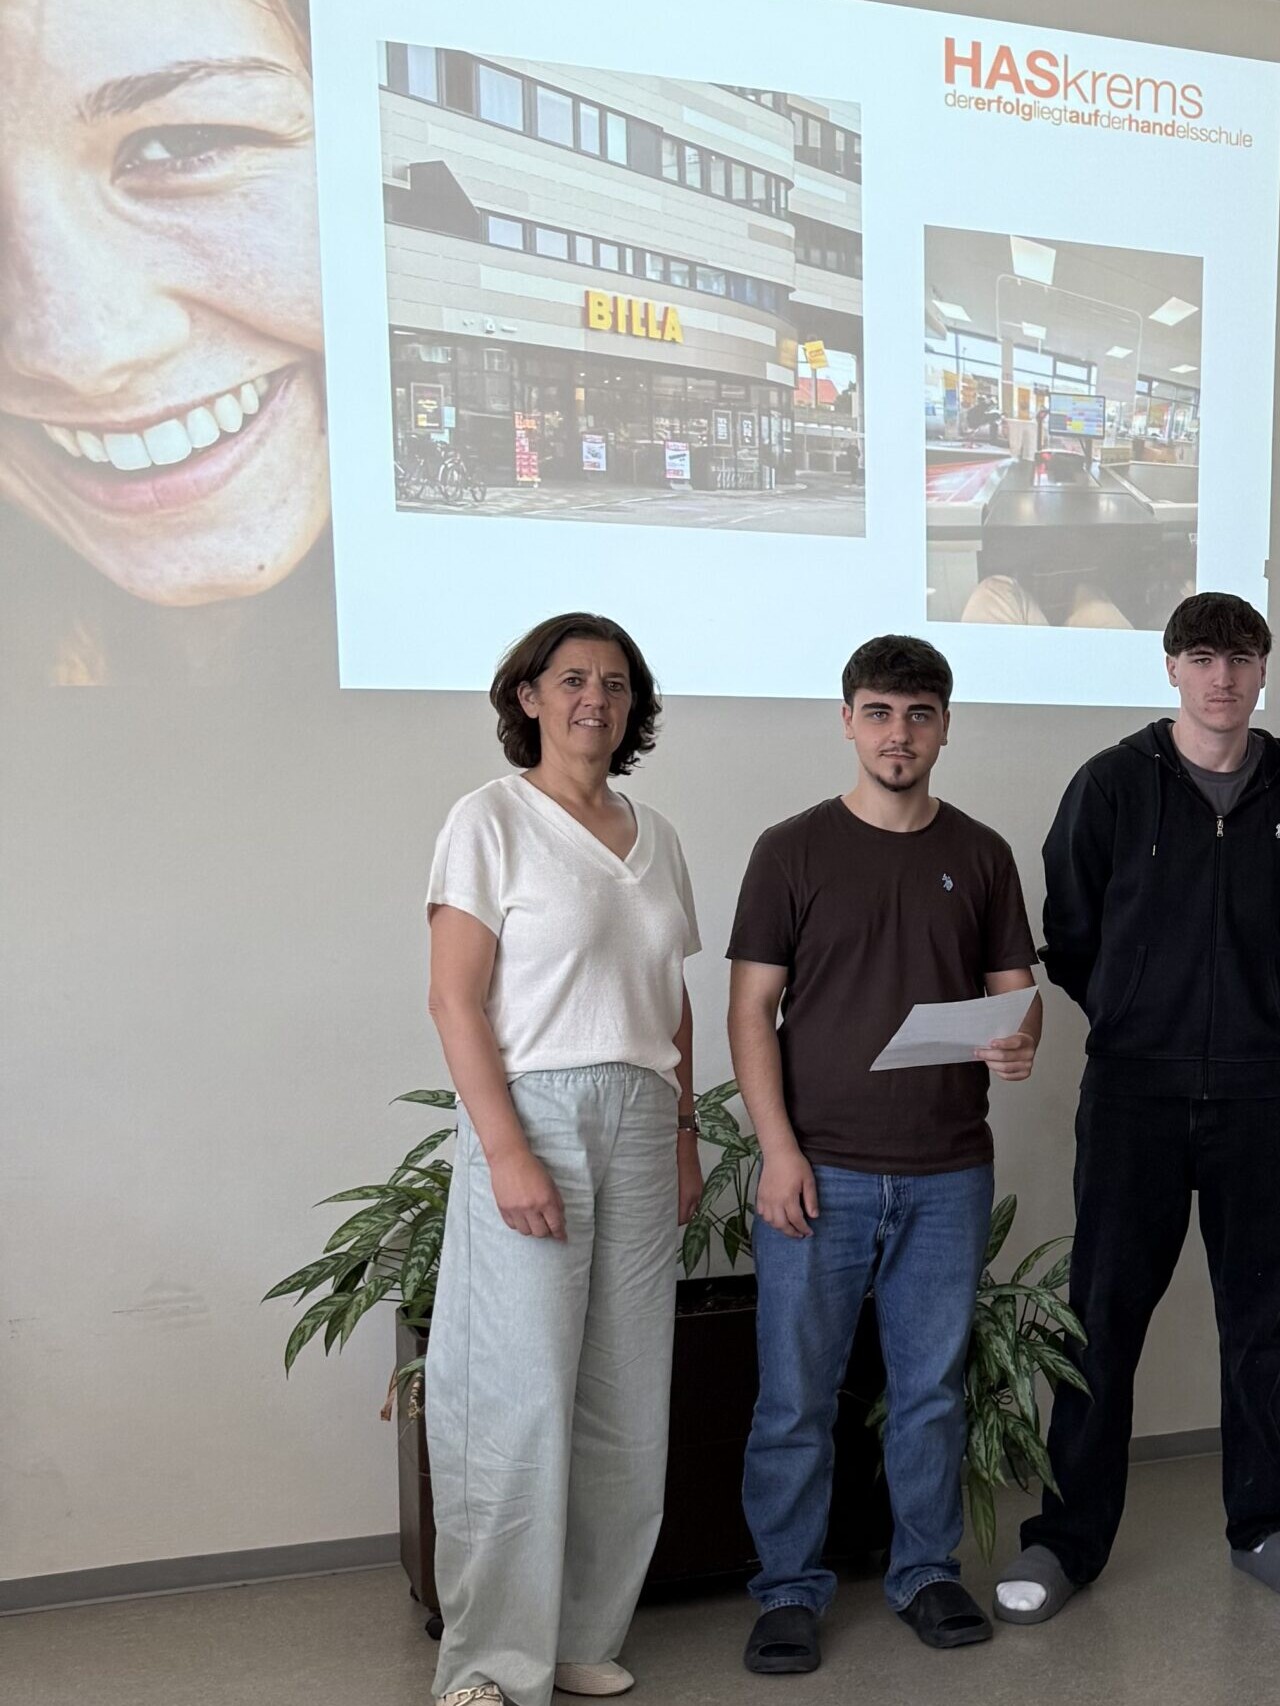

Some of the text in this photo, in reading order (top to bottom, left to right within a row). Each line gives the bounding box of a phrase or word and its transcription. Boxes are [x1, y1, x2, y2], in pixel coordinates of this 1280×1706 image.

[944, 37, 1203, 120] HASkrems
[944, 89, 1253, 148] dererfolgliegtaufderhandelsschule
[584, 289, 684, 344] BILLA
